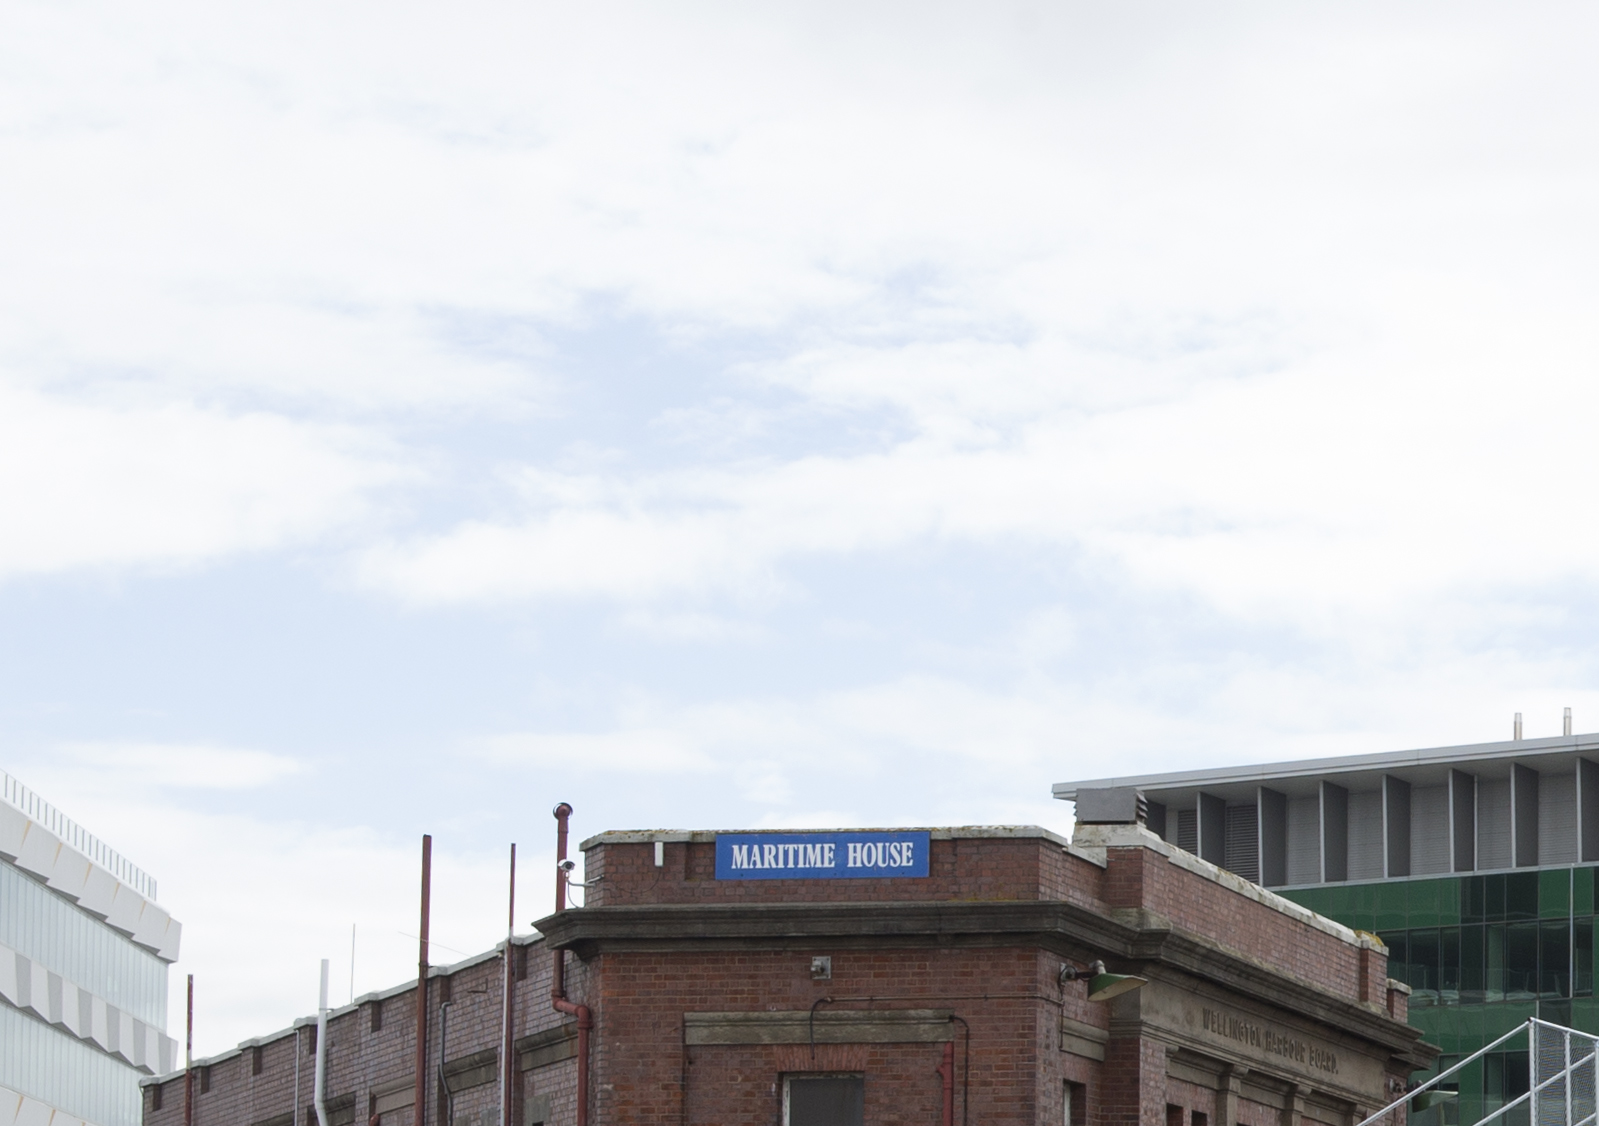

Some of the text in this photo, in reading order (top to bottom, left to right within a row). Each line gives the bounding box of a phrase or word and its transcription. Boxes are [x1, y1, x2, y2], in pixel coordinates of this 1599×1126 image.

[731, 842, 914, 869] MARITIME HOUSE
[1202, 1008, 1261, 1047] WELLINGTON
[1265, 1031, 1305, 1063] HARBOUR
